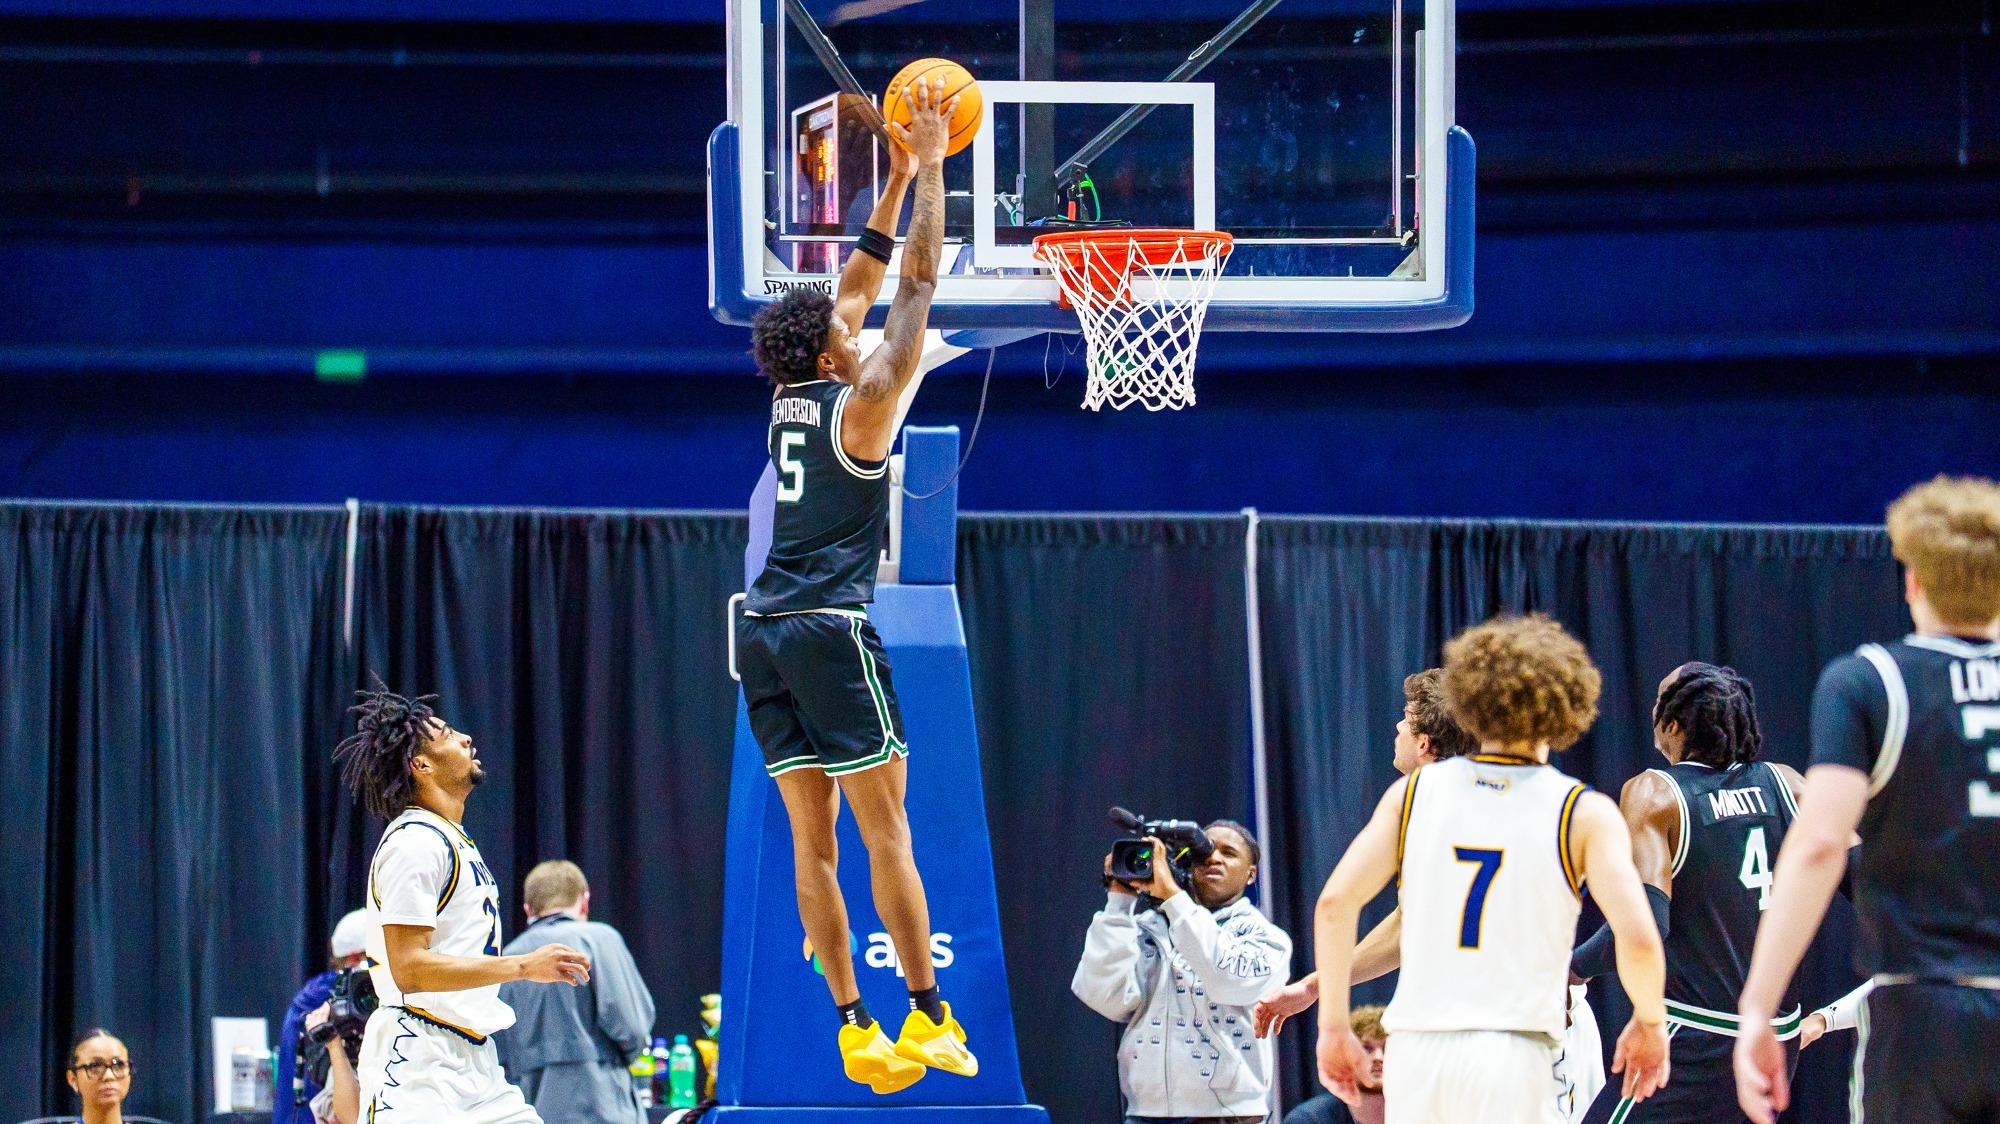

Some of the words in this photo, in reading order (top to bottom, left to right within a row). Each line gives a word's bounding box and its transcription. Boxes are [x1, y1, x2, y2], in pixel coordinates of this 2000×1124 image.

[777, 430, 806, 502] 5
[1453, 845, 1504, 950] 7
[1738, 826, 1773, 911] 4
[865, 932, 954, 977] as
